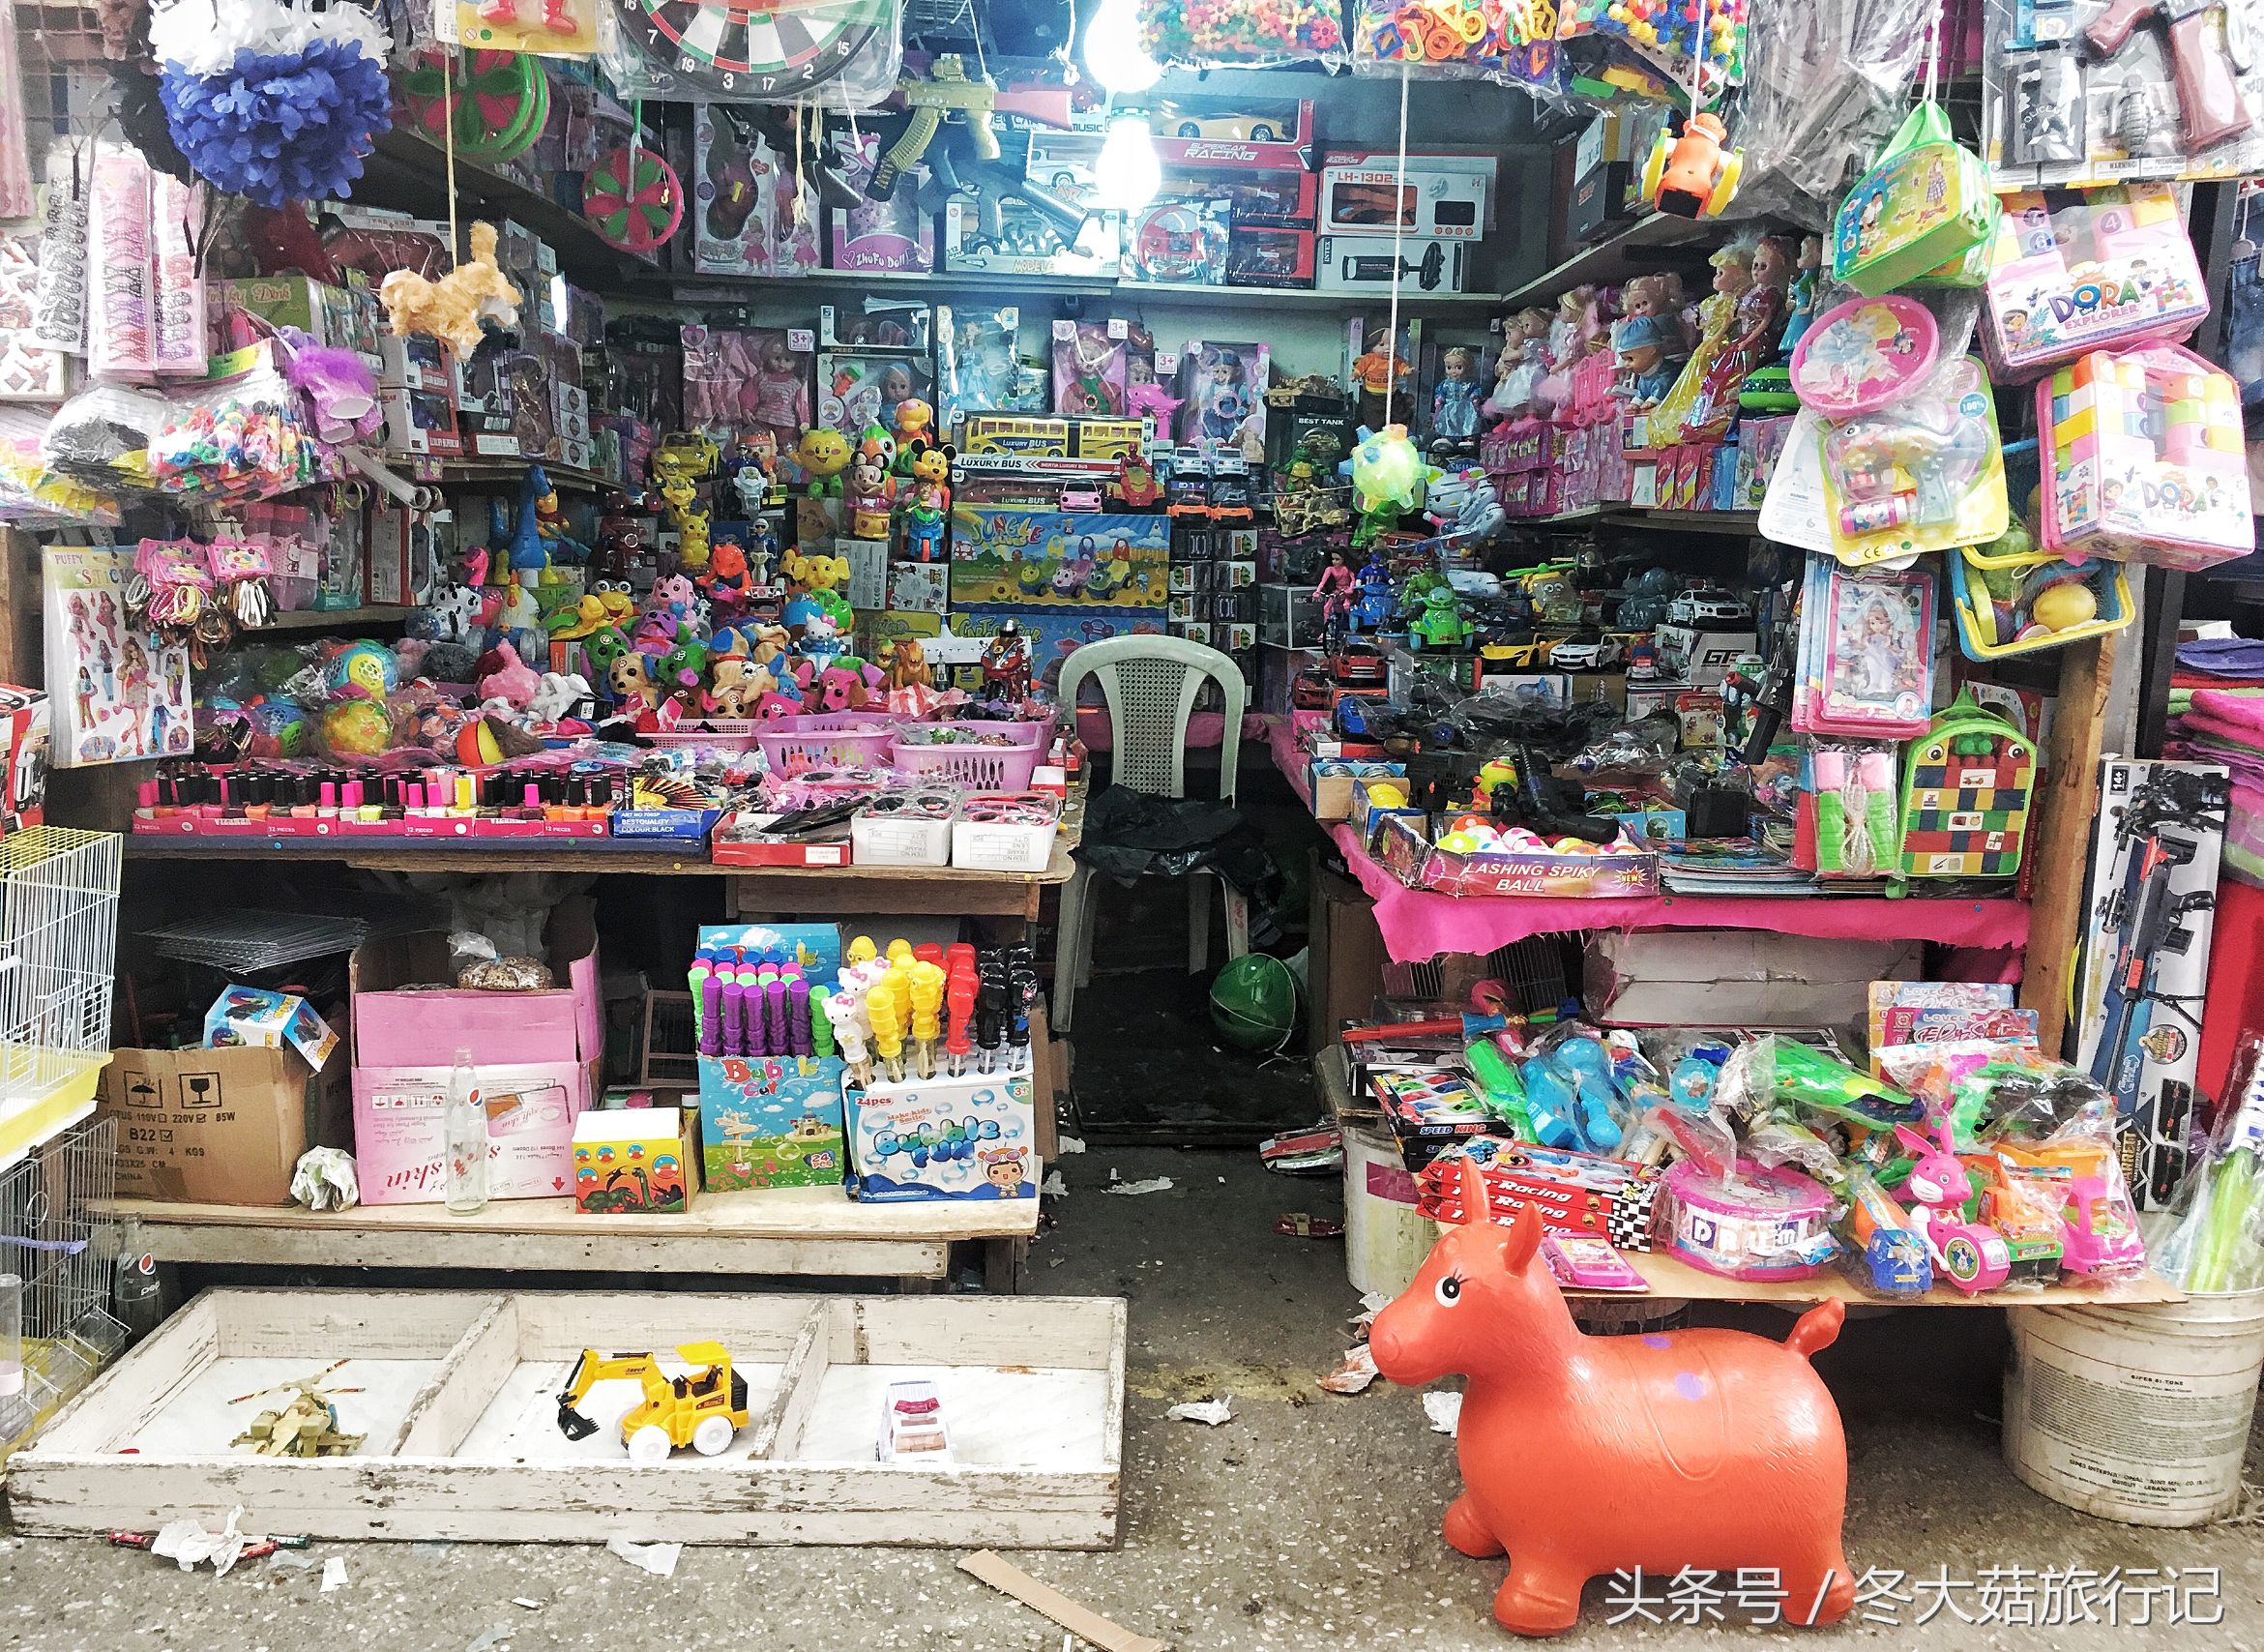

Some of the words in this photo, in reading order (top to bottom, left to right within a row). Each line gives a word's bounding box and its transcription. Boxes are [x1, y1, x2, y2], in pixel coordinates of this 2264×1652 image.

[647, 29, 659, 44] 7
[837, 41, 850, 56] 15
[681, 56, 695, 74] 19
[802, 64, 814, 79] 2
[722, 75, 735, 89] 3
[762, 76, 777, 91] 17
[2020, 105, 2061, 131] POLICEM
[1184, 150, 1258, 162] RACING
[1337, 171, 1394, 183] LH-1302
[1324, 238, 1333, 263] INTEX
[886, 251, 906, 268] Doll
[2048, 278, 2141, 324] DORA
[2065, 304, 2140, 330] EXPLORER
[791, 333, 808, 343] 3+
[1160, 356, 1175, 366] 3+
[1961, 400, 1985, 413] 100%
[1002, 439, 1028, 448] LUXURY
[1028, 438, 1047, 448] BUS
[960, 458, 999, 468] LUXURY
[1001, 459, 1022, 468] BUS
[1027, 496, 1046, 505] BUS
[2141, 478, 2208, 514] DORA
[969, 514, 1045, 546] JUNGLE
[54, 554, 84, 566] PUFFY
[80, 567, 133, 585] STICK
[2113, 771, 2123, 790] 14+
[1547, 866, 1601, 879] SPIKY
[1620, 873, 1642, 883] NEW!
[1495, 878, 1545, 892] BALL
[1903, 988, 1955, 997] LOVELY
[1923, 1013, 1977, 1022] LOVELY
[856, 1096, 893, 1107] 24pcs
[172, 1113, 193, 1123] 220V
[216, 1112, 236, 1122] 85W
[887, 1112, 910, 1122] Make
[910, 1107, 931, 1116] kids
[898, 1114, 924, 1123] Smile
[129, 1129, 157, 1141] B22
[873, 1115, 1002, 1157] Bubble
[1419, 1125, 1454, 1136] SPEED
[1454, 1123, 1487, 1135] KING
[810, 1153, 830, 1163] 24
[387, 1161, 443, 1190] skin
[140, 1280, 161, 1296] pep
